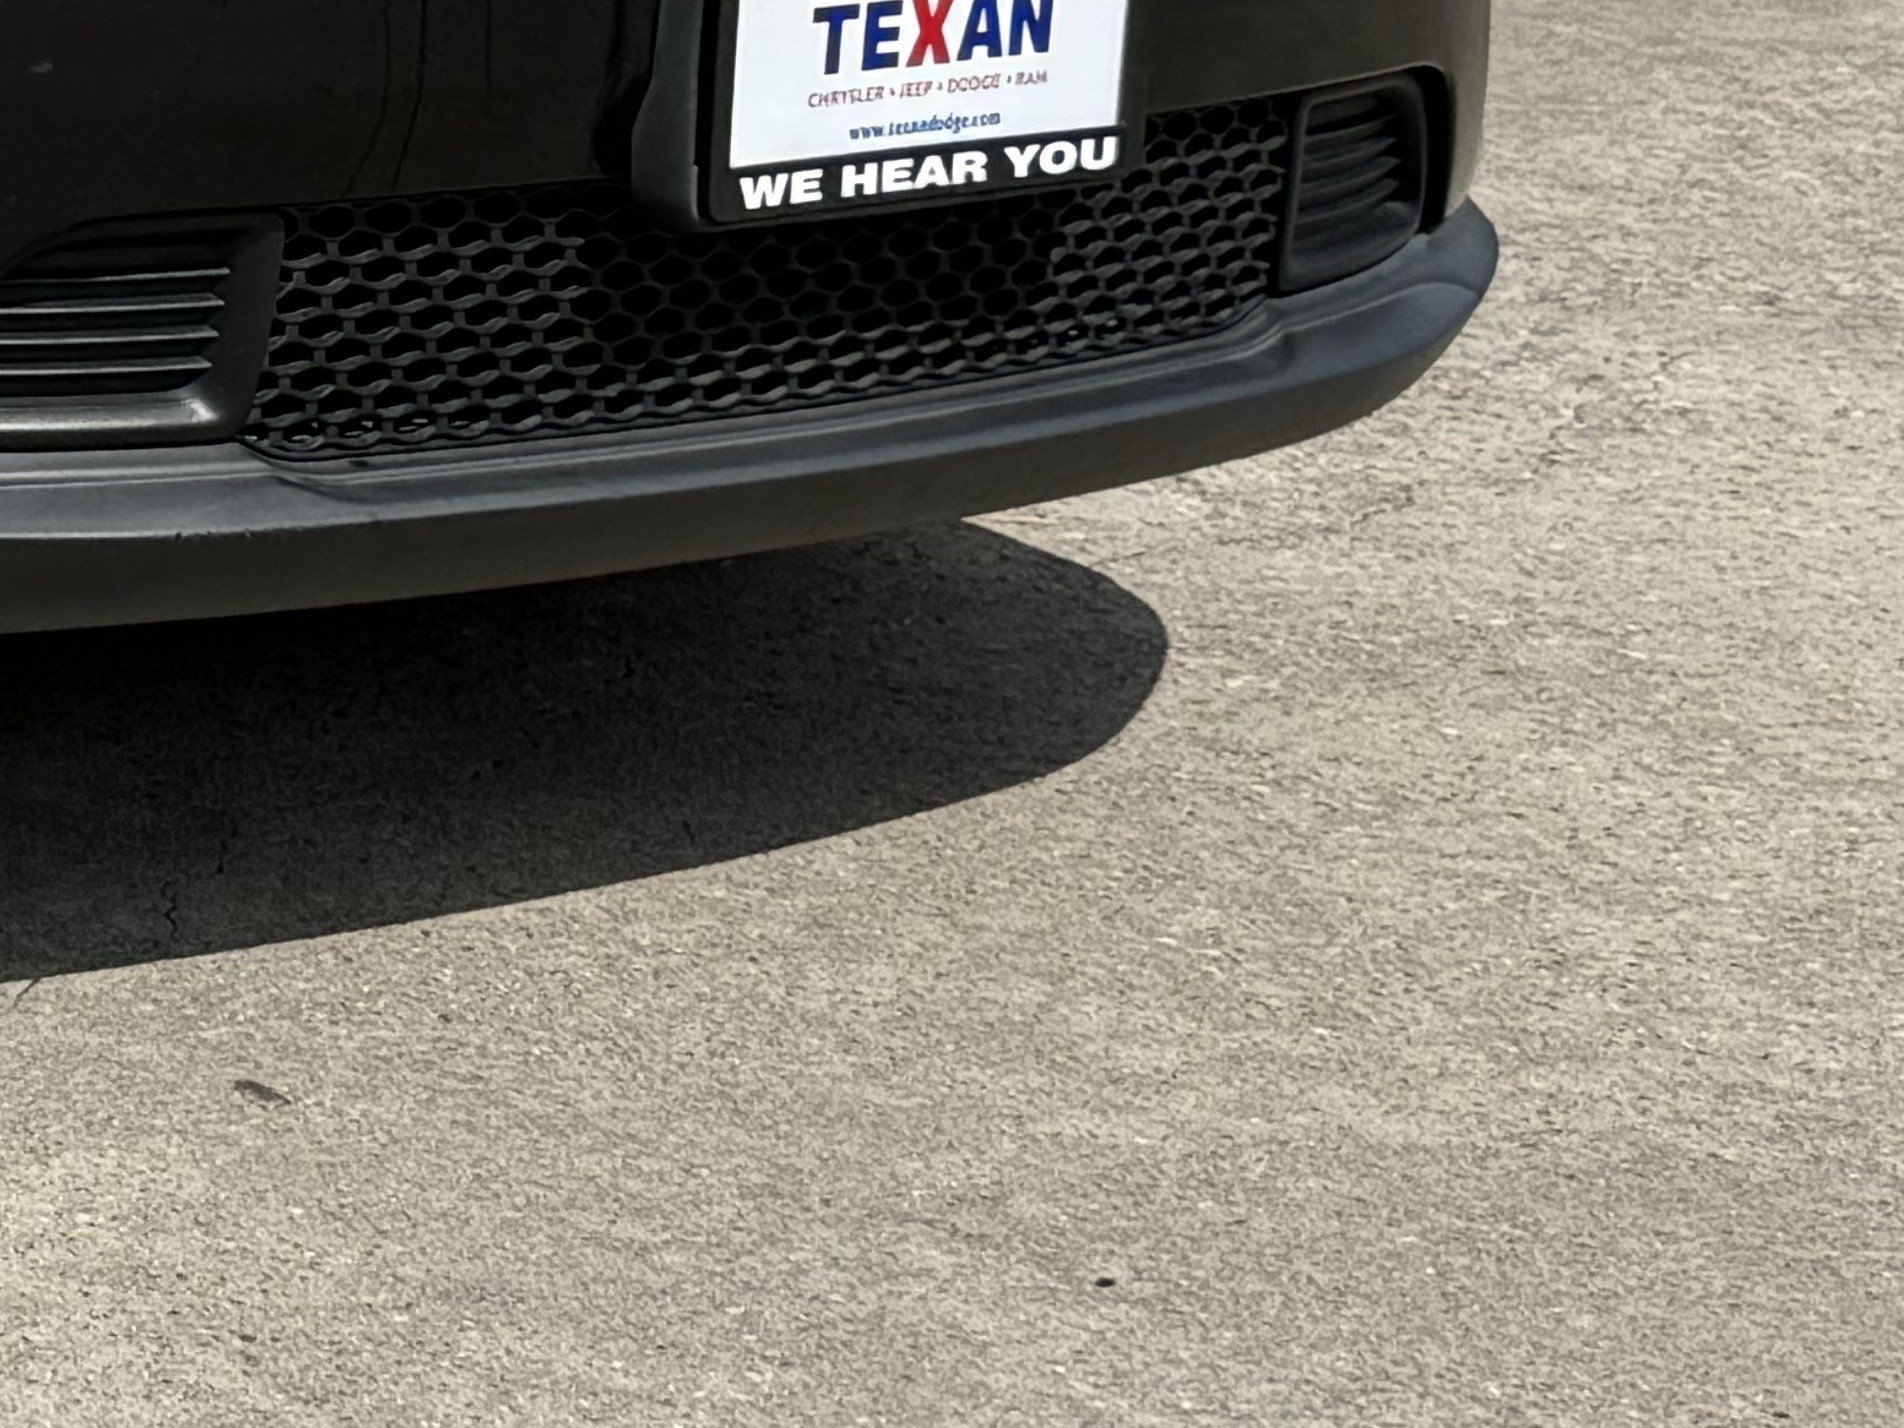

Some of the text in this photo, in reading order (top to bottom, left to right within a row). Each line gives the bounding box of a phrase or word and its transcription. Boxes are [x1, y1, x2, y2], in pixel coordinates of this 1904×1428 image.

[808, 86, 885, 108] CHRYSLER
[899, 80, 934, 99] JEEP
[1014, 70, 1049, 86] RAM
[738, 135, 1120, 211] WE HEAR YOU
